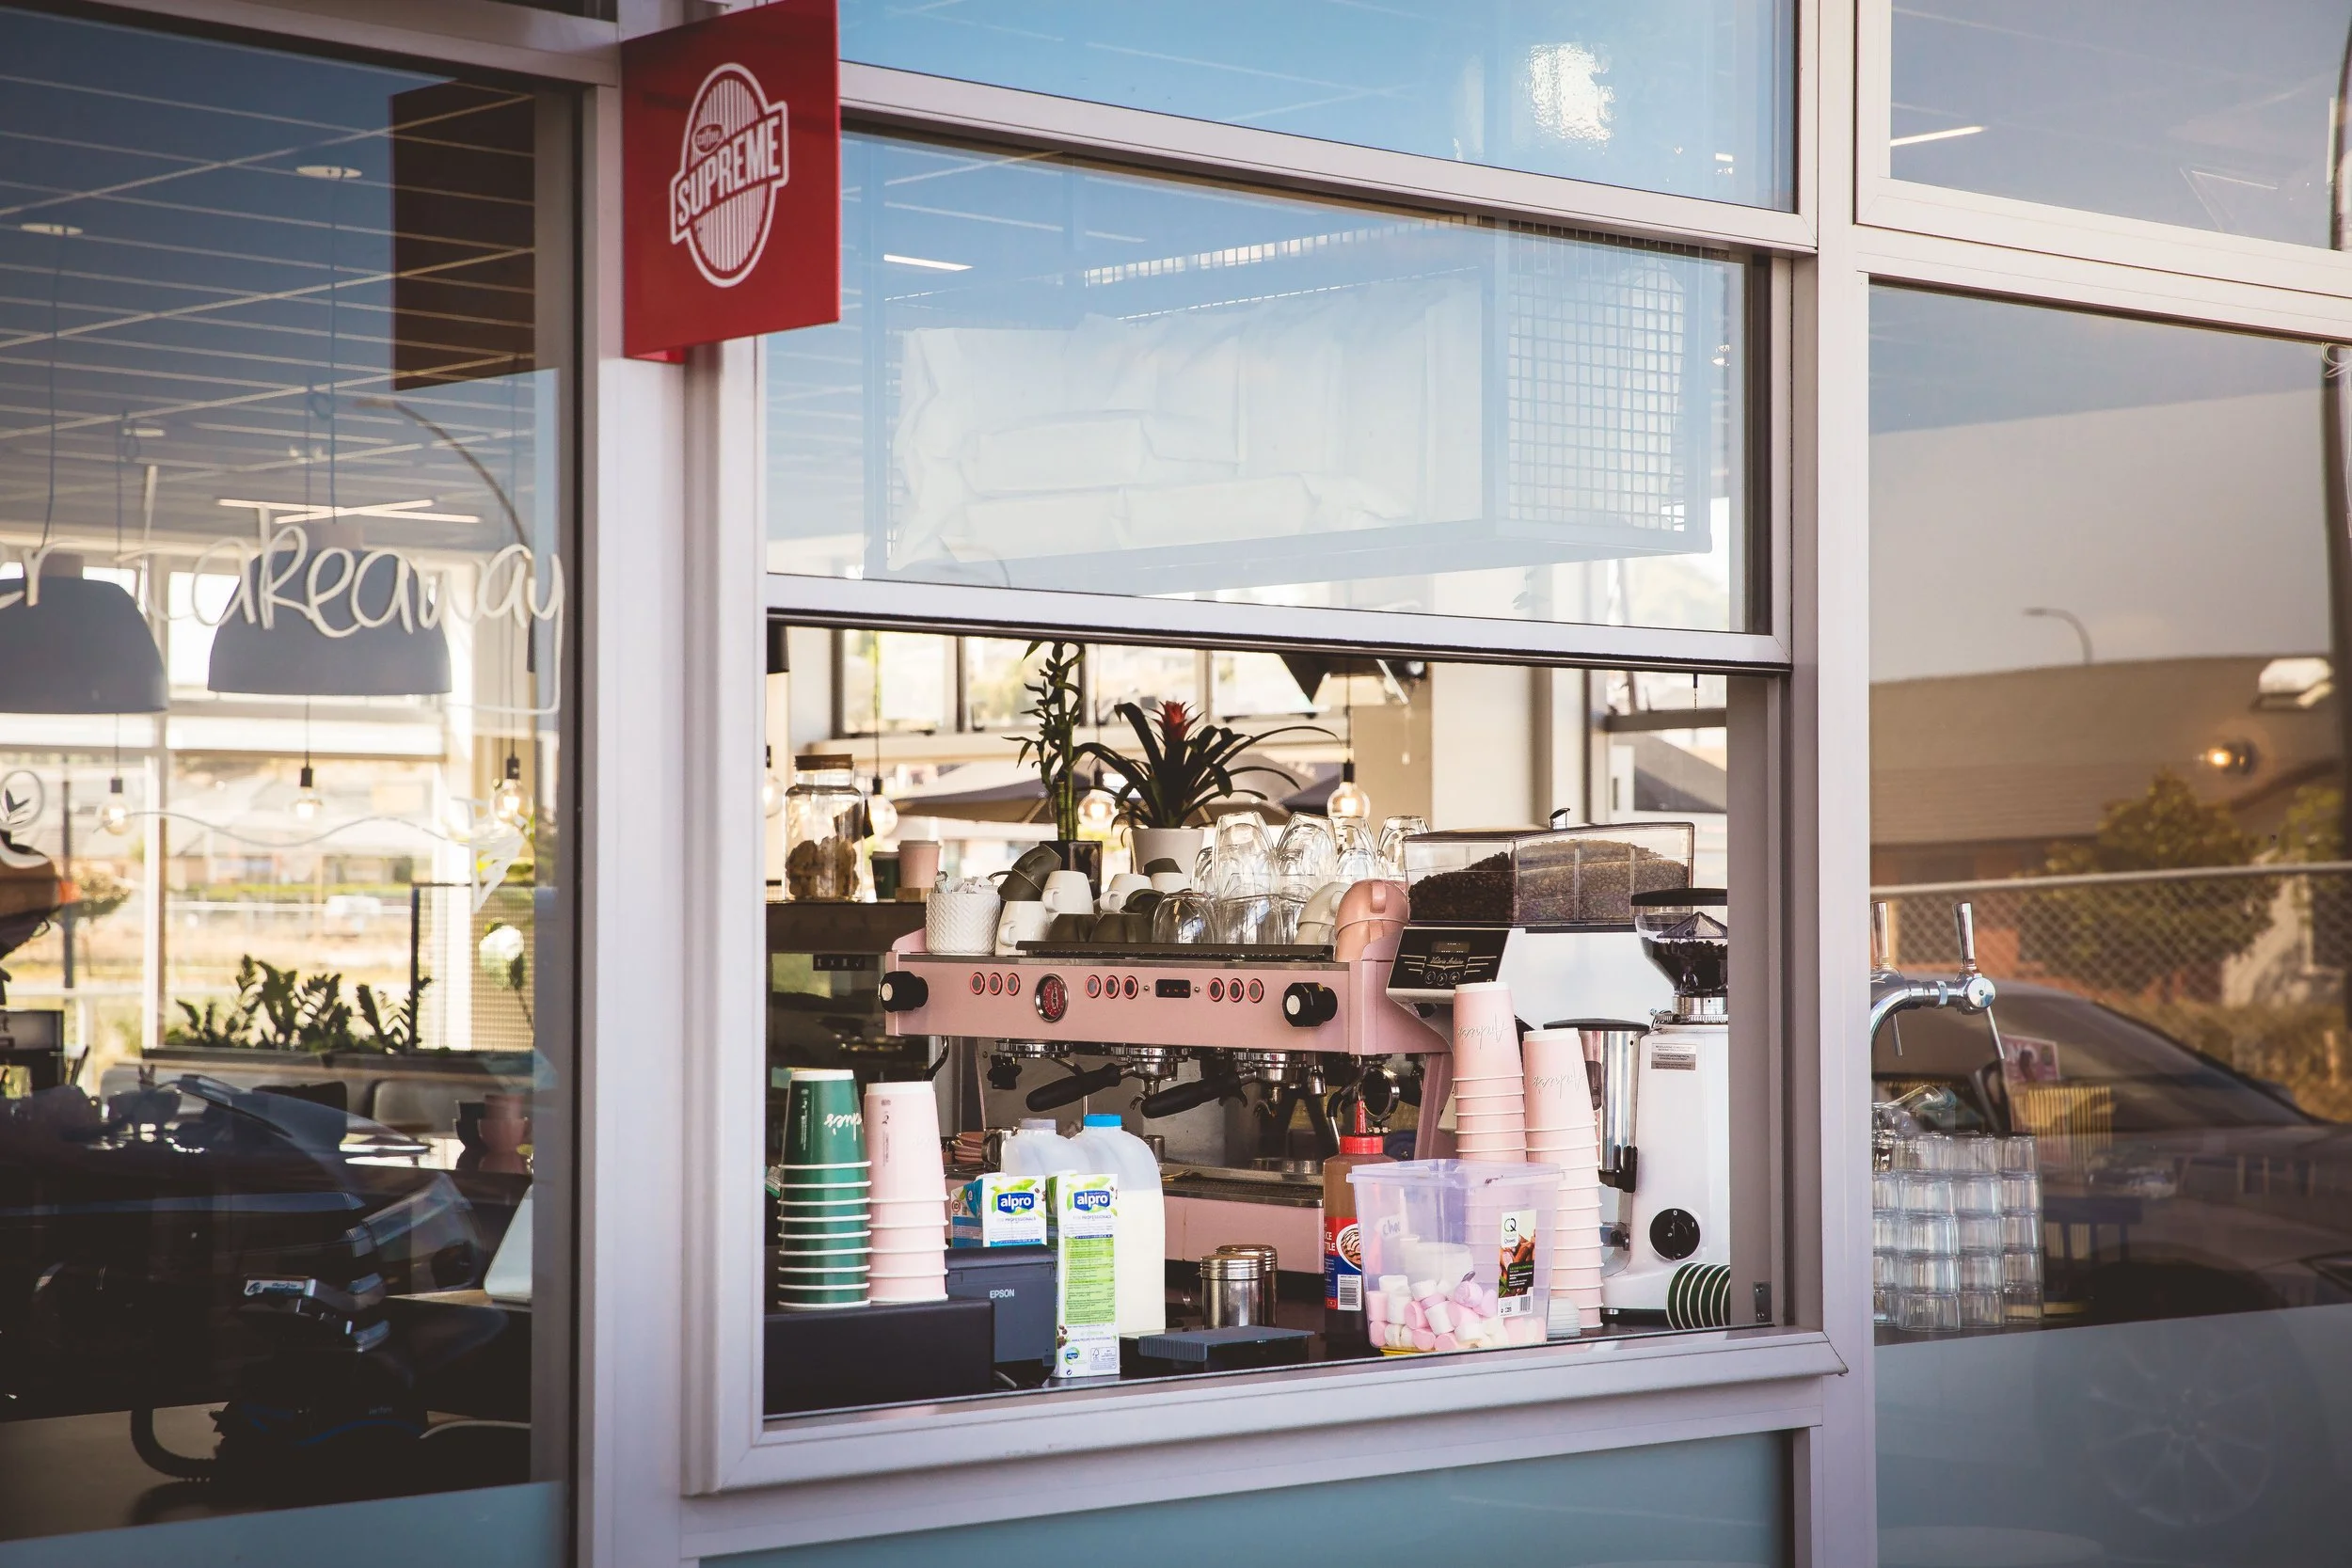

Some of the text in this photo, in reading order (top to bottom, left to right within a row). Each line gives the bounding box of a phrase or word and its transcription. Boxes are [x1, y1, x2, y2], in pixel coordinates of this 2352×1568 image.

[677, 116, 781, 226] SUPREME
[824, 1112, 863, 1143] chie's
[1000, 1195, 1032, 1212] alpro
[1076, 1192, 1108, 1210] alpro
[990, 1289, 1015, 1299] EPSON
